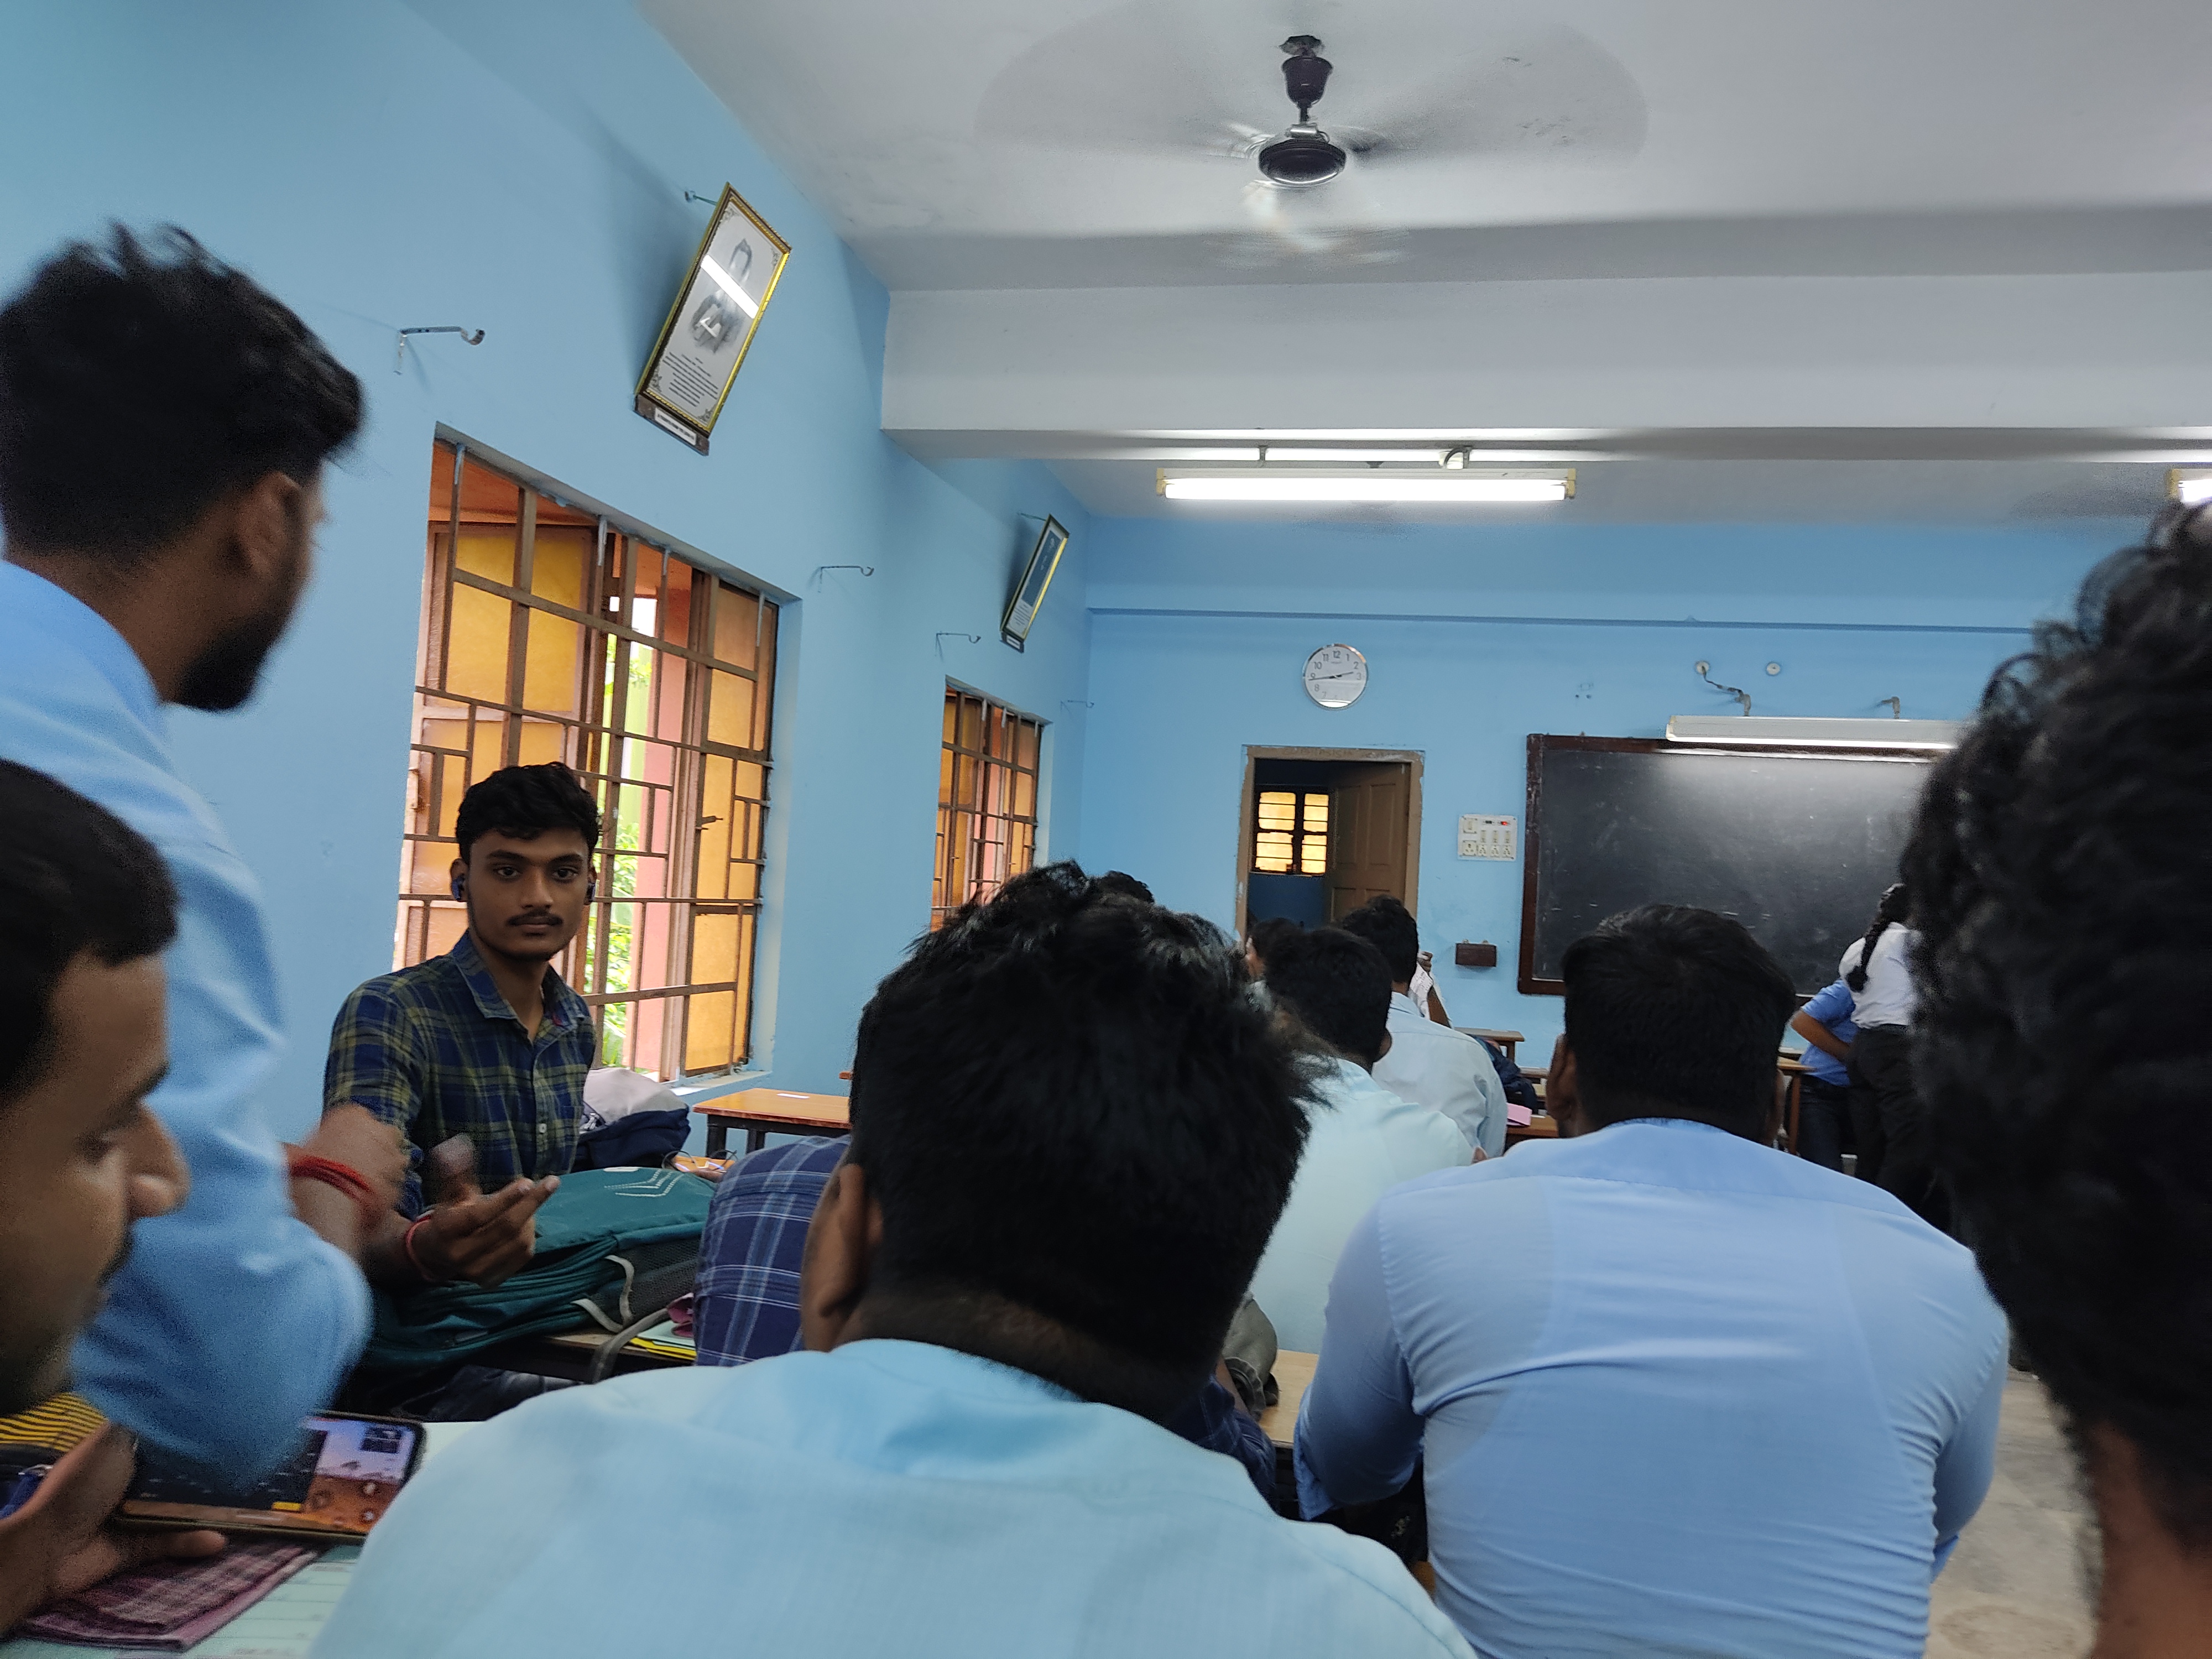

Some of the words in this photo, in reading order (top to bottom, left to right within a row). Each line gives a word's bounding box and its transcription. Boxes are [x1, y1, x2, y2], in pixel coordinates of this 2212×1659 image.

[1322, 653, 1329, 661] 11
[1333, 650, 1341, 659] 12
[1346, 653, 1350, 661] 1
[1313, 661, 1322, 670] 10
